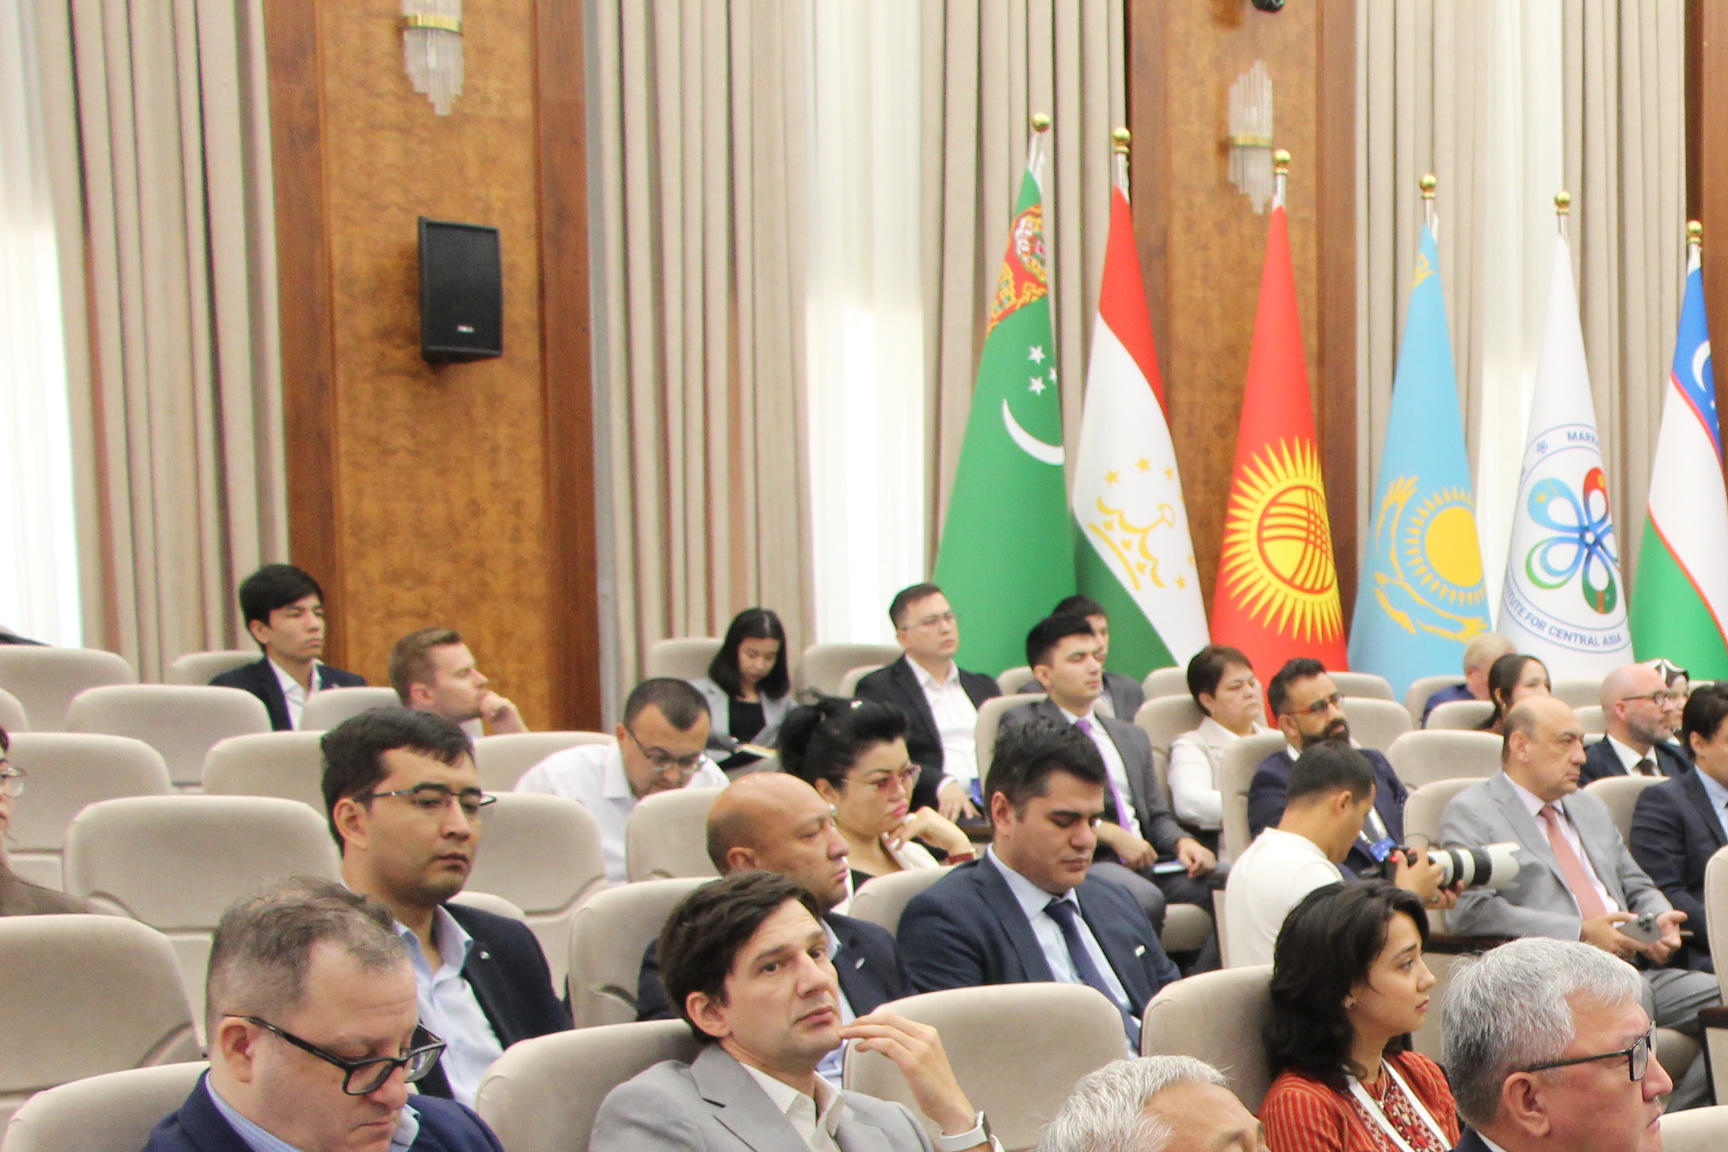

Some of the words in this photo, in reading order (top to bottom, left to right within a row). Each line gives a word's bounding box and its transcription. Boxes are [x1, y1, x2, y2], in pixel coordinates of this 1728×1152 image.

[1525, 611, 1547, 631] FOR
[1548, 625, 1600, 646] CENTRAL
[1603, 633, 1622, 646] ASIA
